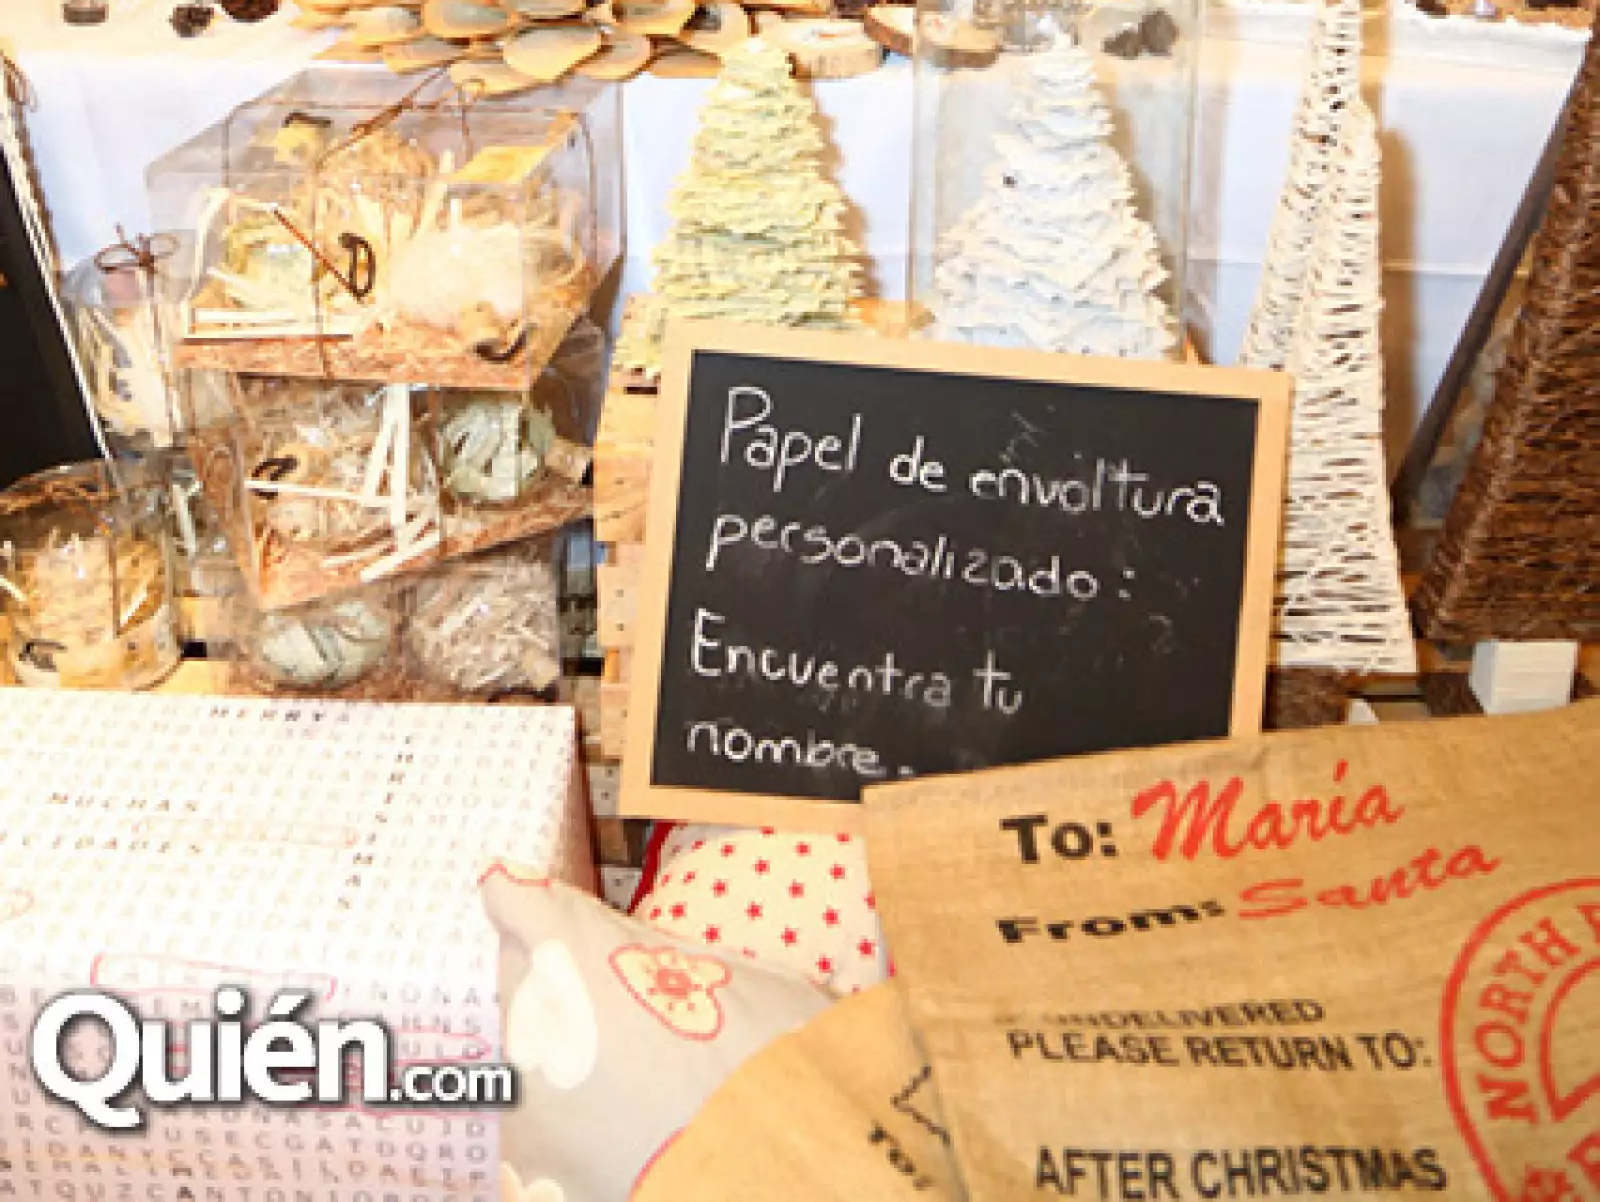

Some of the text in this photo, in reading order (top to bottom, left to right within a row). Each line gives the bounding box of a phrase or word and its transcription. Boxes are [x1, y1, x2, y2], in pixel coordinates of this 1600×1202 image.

[720, 385, 1227, 526] Papel de envoltura
[690, 607, 1024, 716] Encuentra tu
[999, 760, 1406, 866] To: María
[995, 843, 1501, 945] From: Santa
[1006, 1028, 1436, 1071] PLEASE RETURN TO:
[1473, 915, 1582, 1128] NORTH
[1036, 1145, 1449, 1200] AFTER CHRISTMAS
